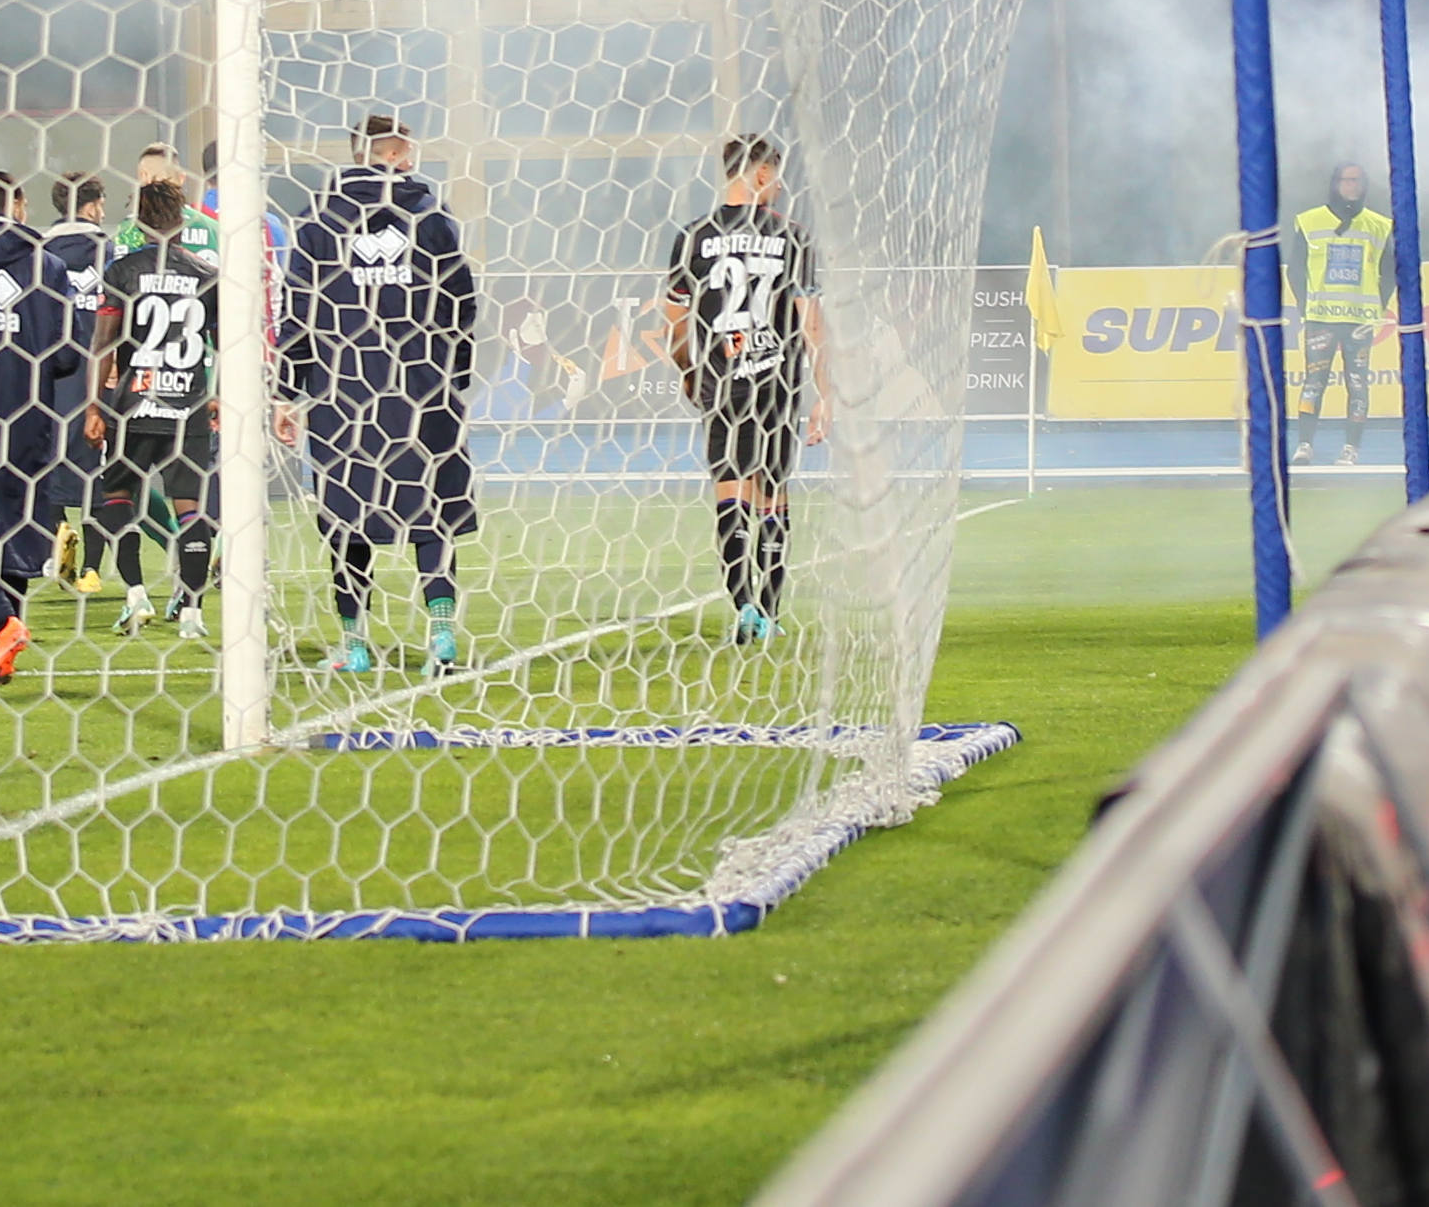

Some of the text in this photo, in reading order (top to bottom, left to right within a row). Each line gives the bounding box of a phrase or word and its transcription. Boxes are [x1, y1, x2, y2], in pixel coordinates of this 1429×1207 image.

[709, 257, 785, 333] 27
[973, 291, 1026, 307] SUSH
[130, 295, 206, 370] 23
[970, 332, 1026, 348] PIZZA
[965, 373, 1025, 389] DRINK
